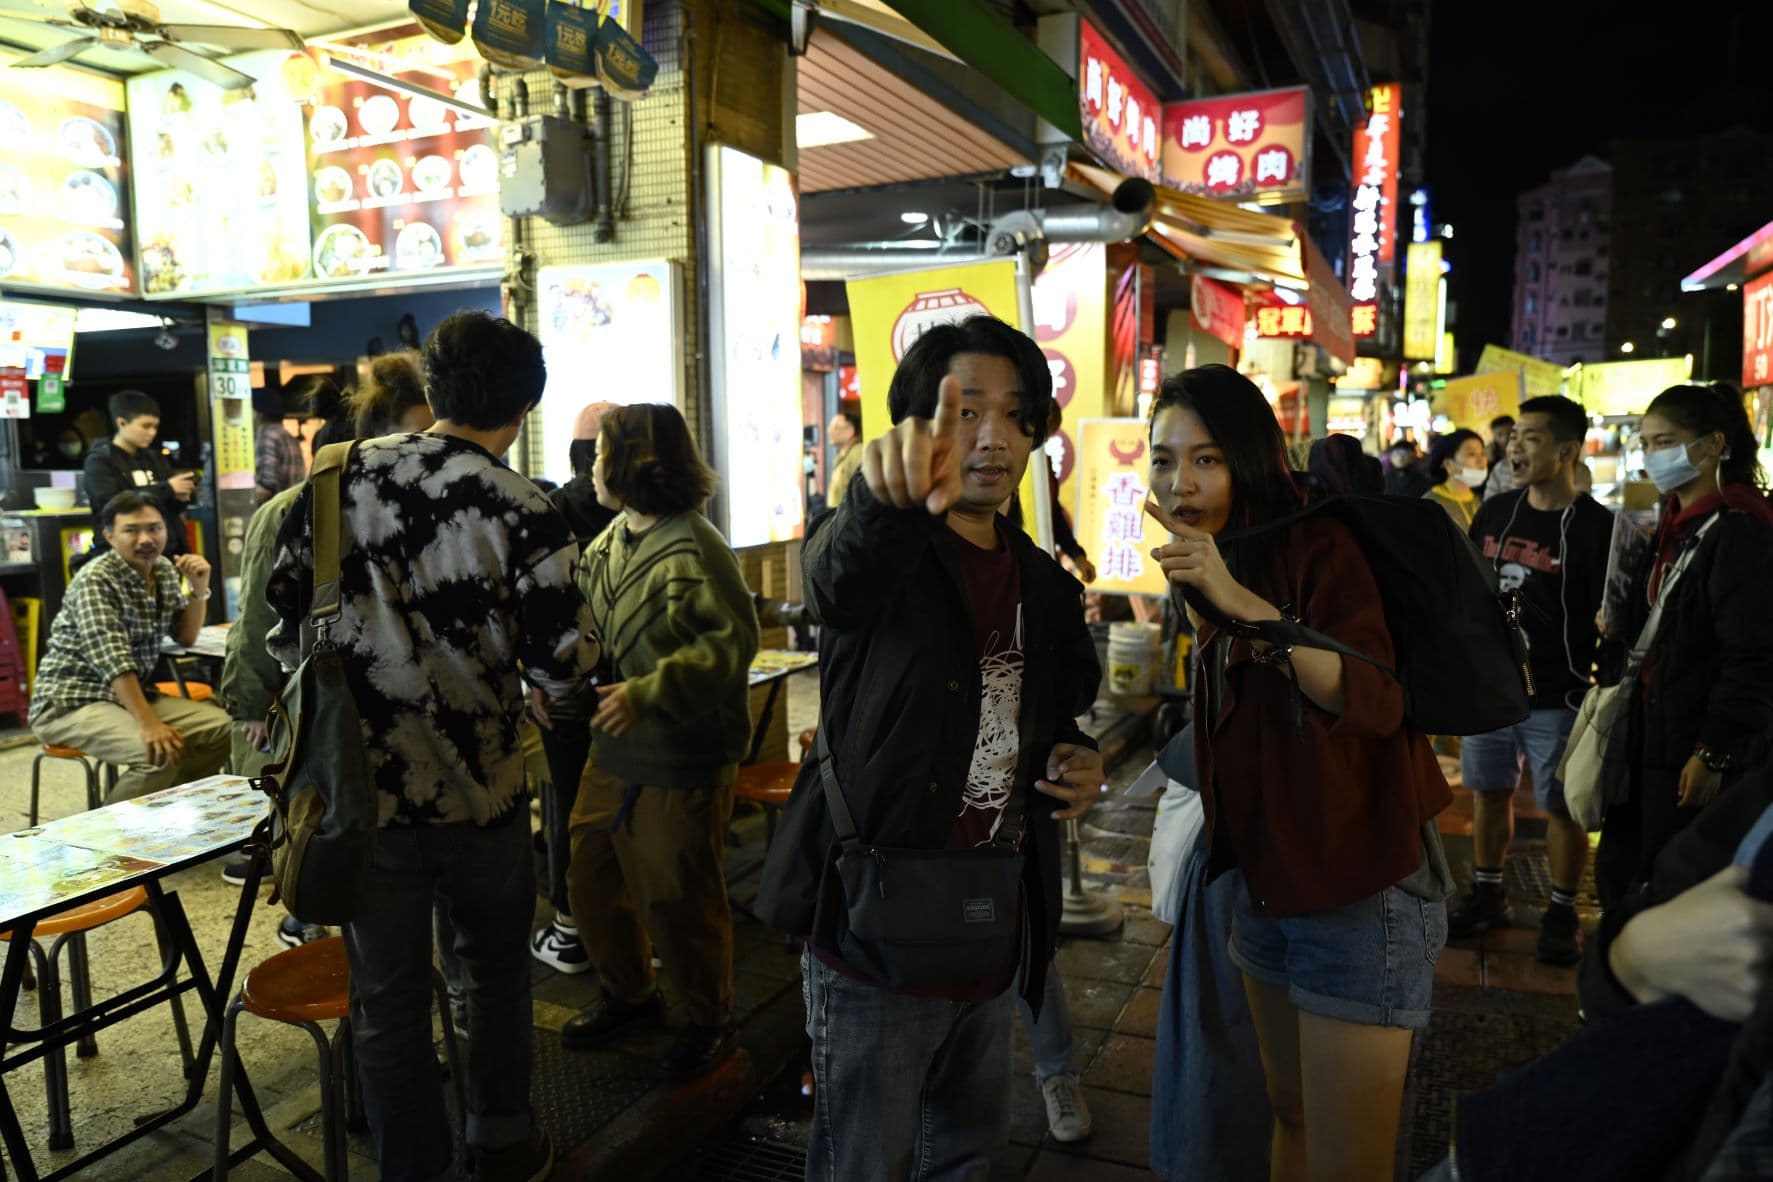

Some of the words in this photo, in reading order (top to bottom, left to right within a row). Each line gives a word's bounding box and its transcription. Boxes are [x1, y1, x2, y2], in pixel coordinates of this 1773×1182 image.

[1182, 109, 1270, 148] 尚好
[1207, 149, 1289, 187] 烤肉
[1257, 307, 1313, 336] 冠軍
[216, 376, 237, 395] 30
[1105, 473, 1145, 579] 香雞排
